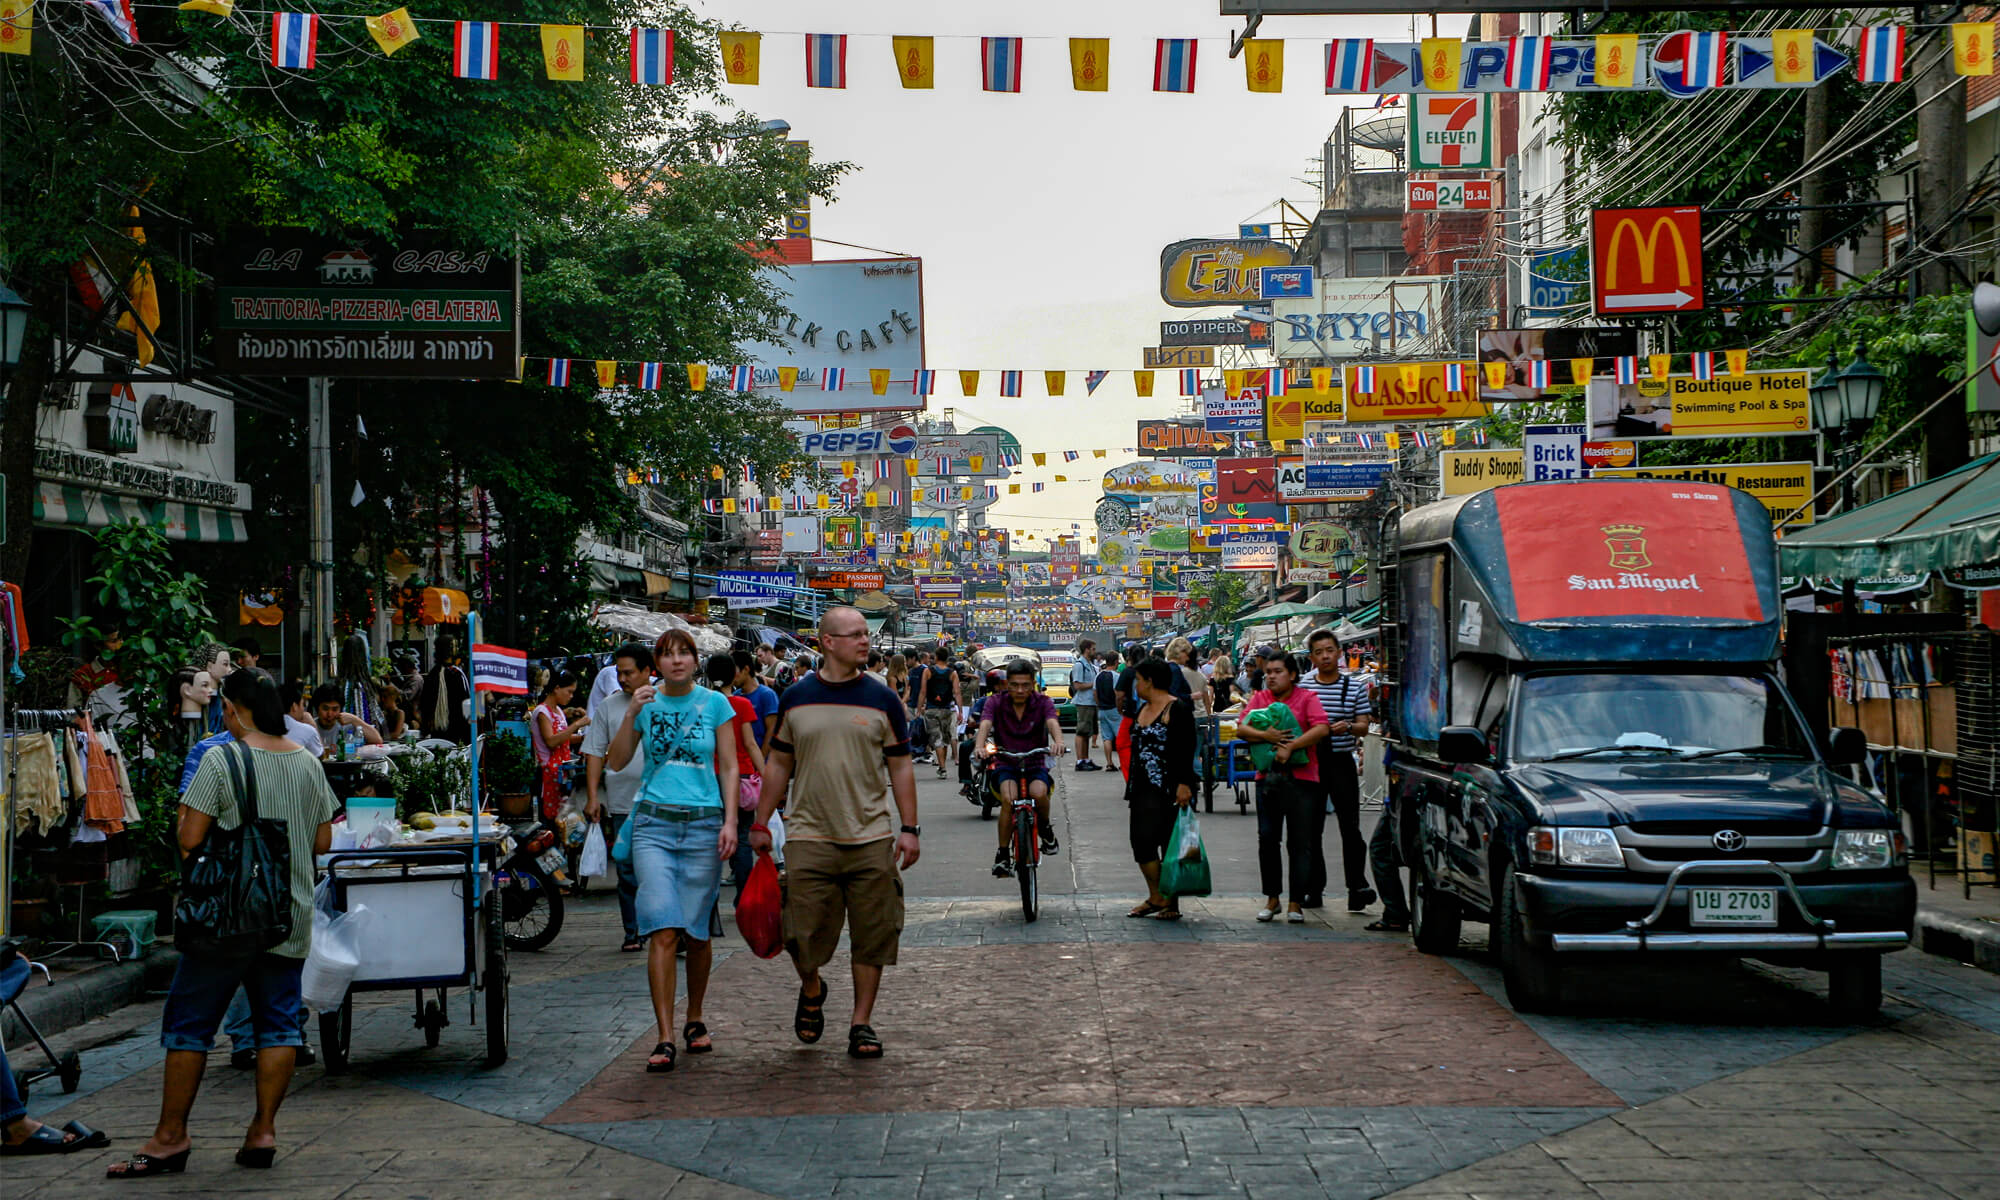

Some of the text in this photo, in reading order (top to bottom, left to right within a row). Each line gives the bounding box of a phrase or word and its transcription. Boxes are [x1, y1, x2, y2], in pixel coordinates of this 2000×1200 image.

[1428, 98, 1477, 166] 7
[1412, 186, 1434, 201] เปิด
[1438, 186, 1463, 206] 24
[243, 247, 492, 273] LA CASA
[1270, 273, 1302, 283] PEPSI
[1164, 322, 1244, 335] 100 PIPERS
[1146, 350, 1210, 365] HOTEL
[1675, 376, 1806, 394] Boutique Hotel
[1676, 399, 1806, 414] Swimming Pool & Spa
[805, 431, 883, 451] PEPSI
[1141, 427, 1233, 449] CHIVAS
[1534, 444, 1575, 462] Brick
[1583, 447, 1633, 457] MasterCard
[1454, 457, 1484, 480] Buddy
[1534, 464, 1576, 481] Bar
[1737, 476, 1805, 489] Restaurant
[1223, 546, 1276, 555] MARCOPOLO
[719, 574, 794, 594] MOBILE PHONE
[847, 574, 884, 582] PASSPORT
[1567, 572, 1700, 592] San Miguel
[1728, 892, 1771, 909] 2703
